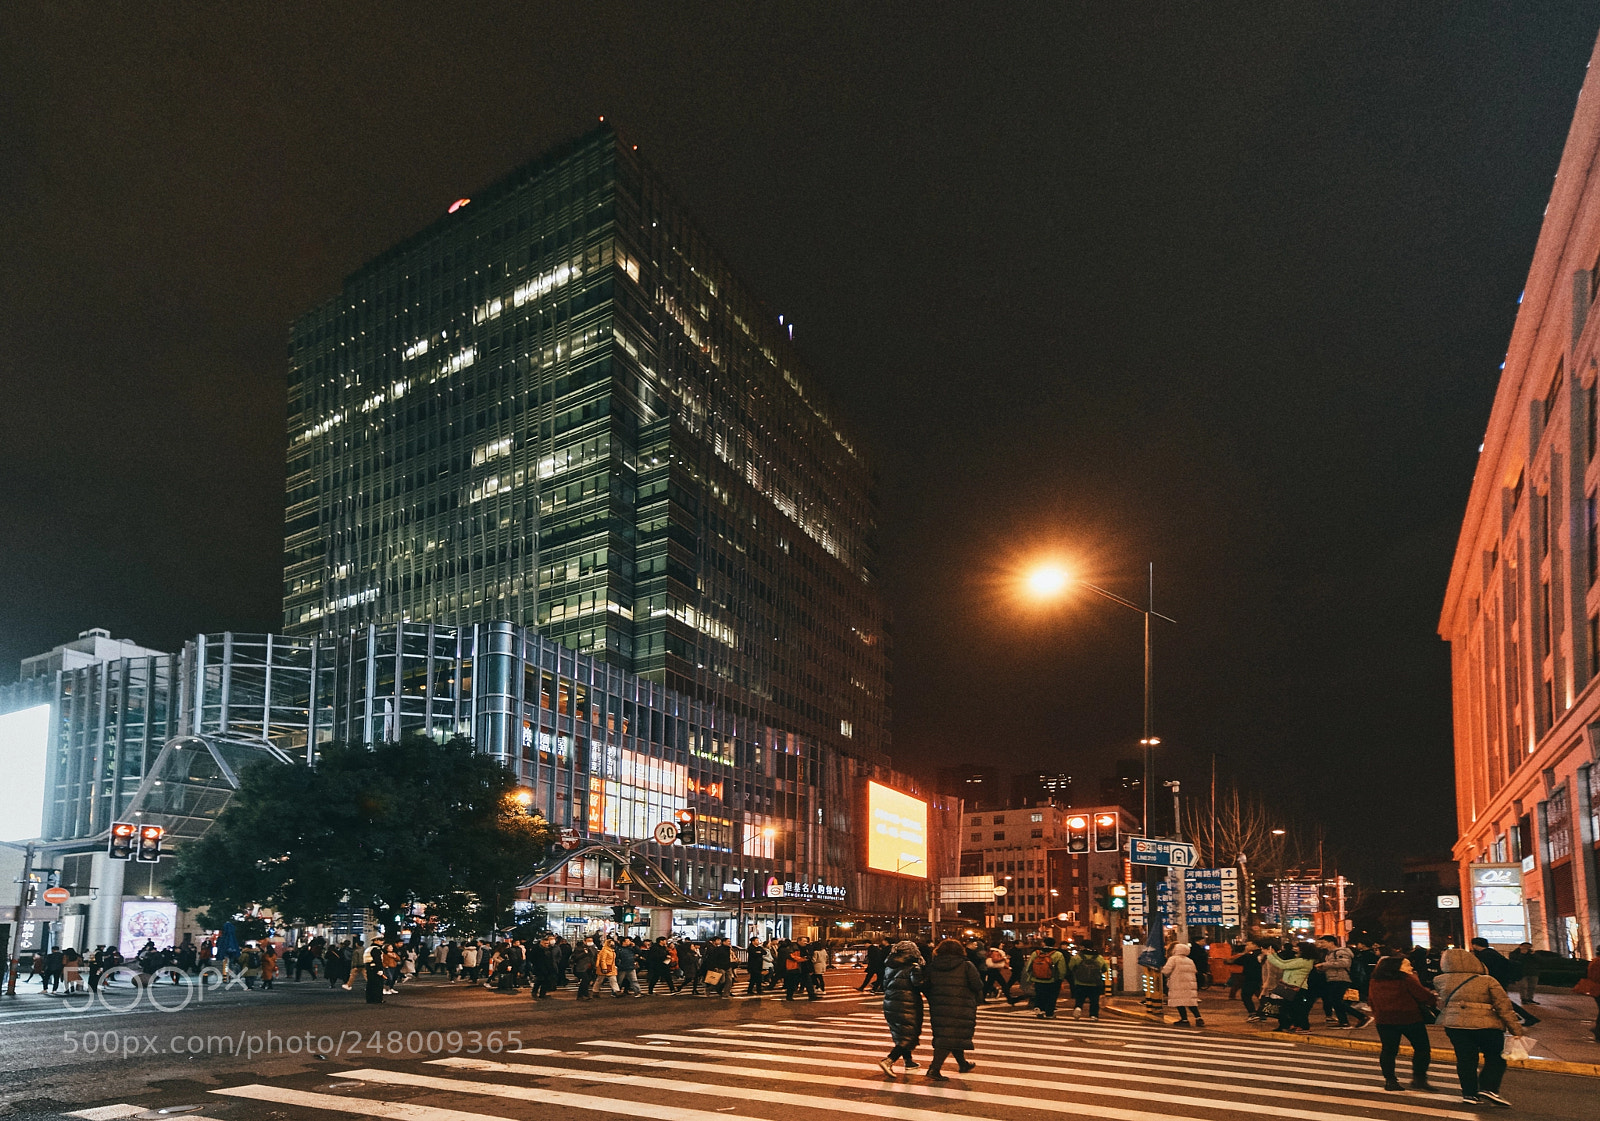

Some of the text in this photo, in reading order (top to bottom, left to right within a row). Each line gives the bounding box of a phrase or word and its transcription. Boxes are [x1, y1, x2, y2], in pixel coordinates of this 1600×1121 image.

[659, 826, 674, 840] 40
[785, 881, 847, 896] 恒基名人购物中心
